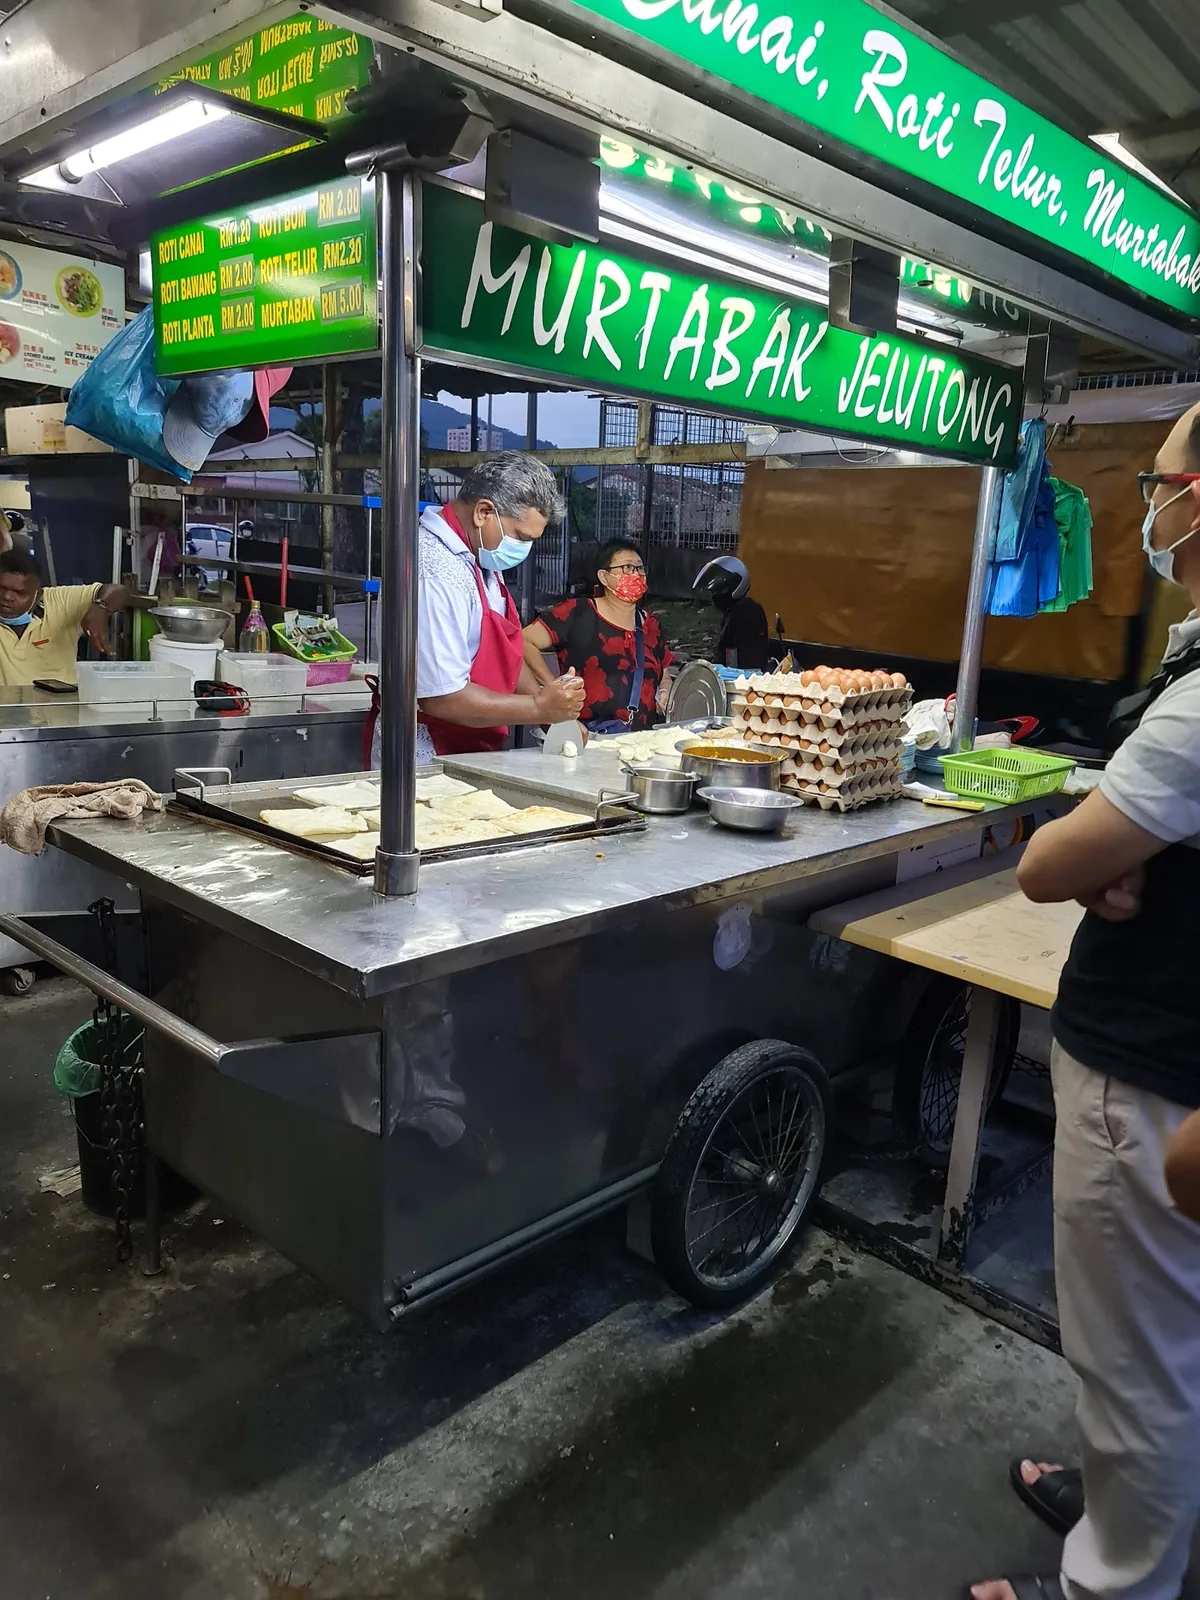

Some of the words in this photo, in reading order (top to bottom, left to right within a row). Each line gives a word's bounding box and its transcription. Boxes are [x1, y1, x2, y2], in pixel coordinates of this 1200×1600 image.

[854, 29, 961, 160] Roti
[973, 98, 1068, 227] Telur,
[259, 210, 281, 239] ROTI
[284, 204, 307, 232] BOM
[319, 190, 335, 219] RM
[336, 185, 360, 216] 2.00
[159, 238, 178, 264] ROTI
[179, 230, 205, 260] CANAI
[260, 256, 283, 284] ROTI
[285, 247, 318, 276] TELUR
[161, 280, 179, 305] ROTI
[181, 271, 217, 301] BAWANG
[220, 266, 234, 290] RM
[235, 260, 253, 287] 2.00
[163, 320, 182, 345] ROTI
[183, 314, 215, 342] PLANTA
[221, 306, 235, 330] RM
[236, 301, 255, 328] 2.00
[261, 296, 316, 329] MURTABAK
[321, 290, 337, 318] RM
[339, 283, 362, 314] 5.00
[461, 220, 829, 402] MURTABAK
[837, 336, 1012, 460] JELUTONG
